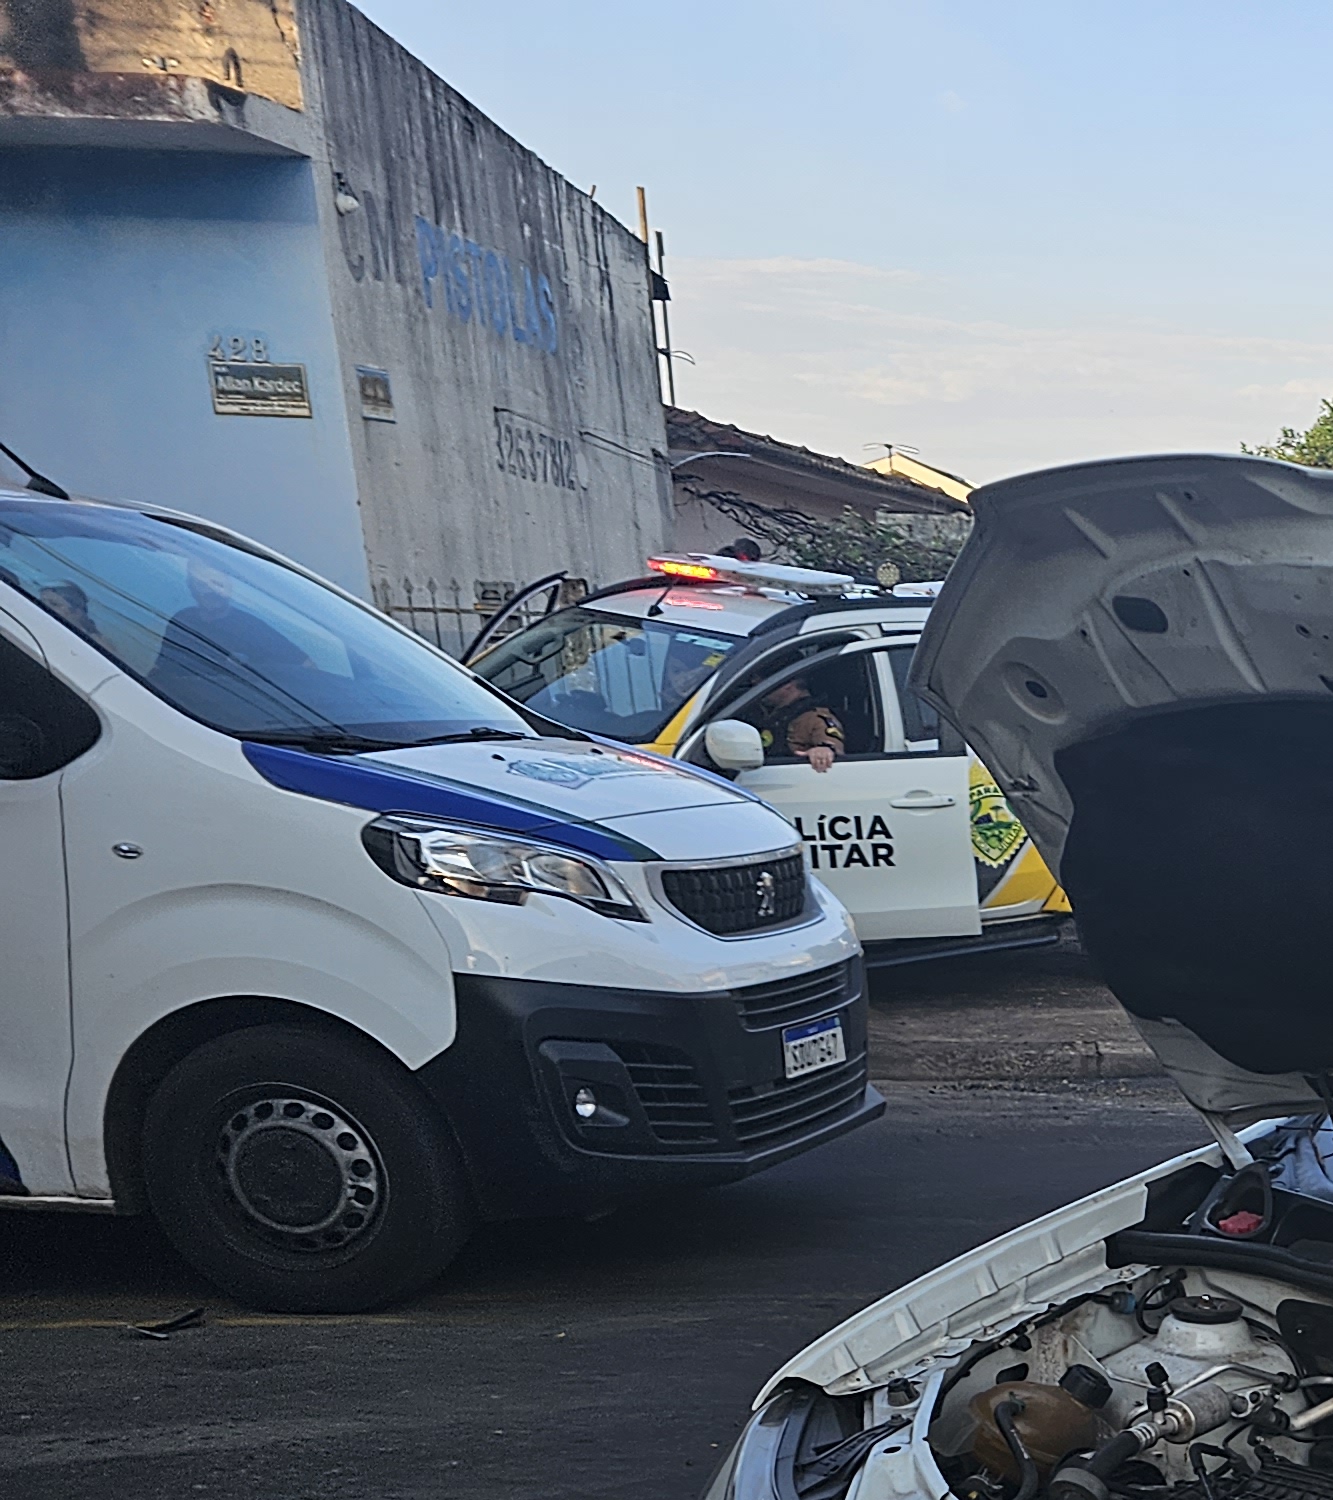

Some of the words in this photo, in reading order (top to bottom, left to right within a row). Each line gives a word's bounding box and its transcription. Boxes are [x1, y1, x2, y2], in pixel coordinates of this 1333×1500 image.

[414, 213, 559, 356] PISTOLAS
[207, 334, 269, 363] 428
[214, 374, 250, 392] Allan
[253, 375, 302, 394] Kardec
[811, 842, 897, 870] ITAR
